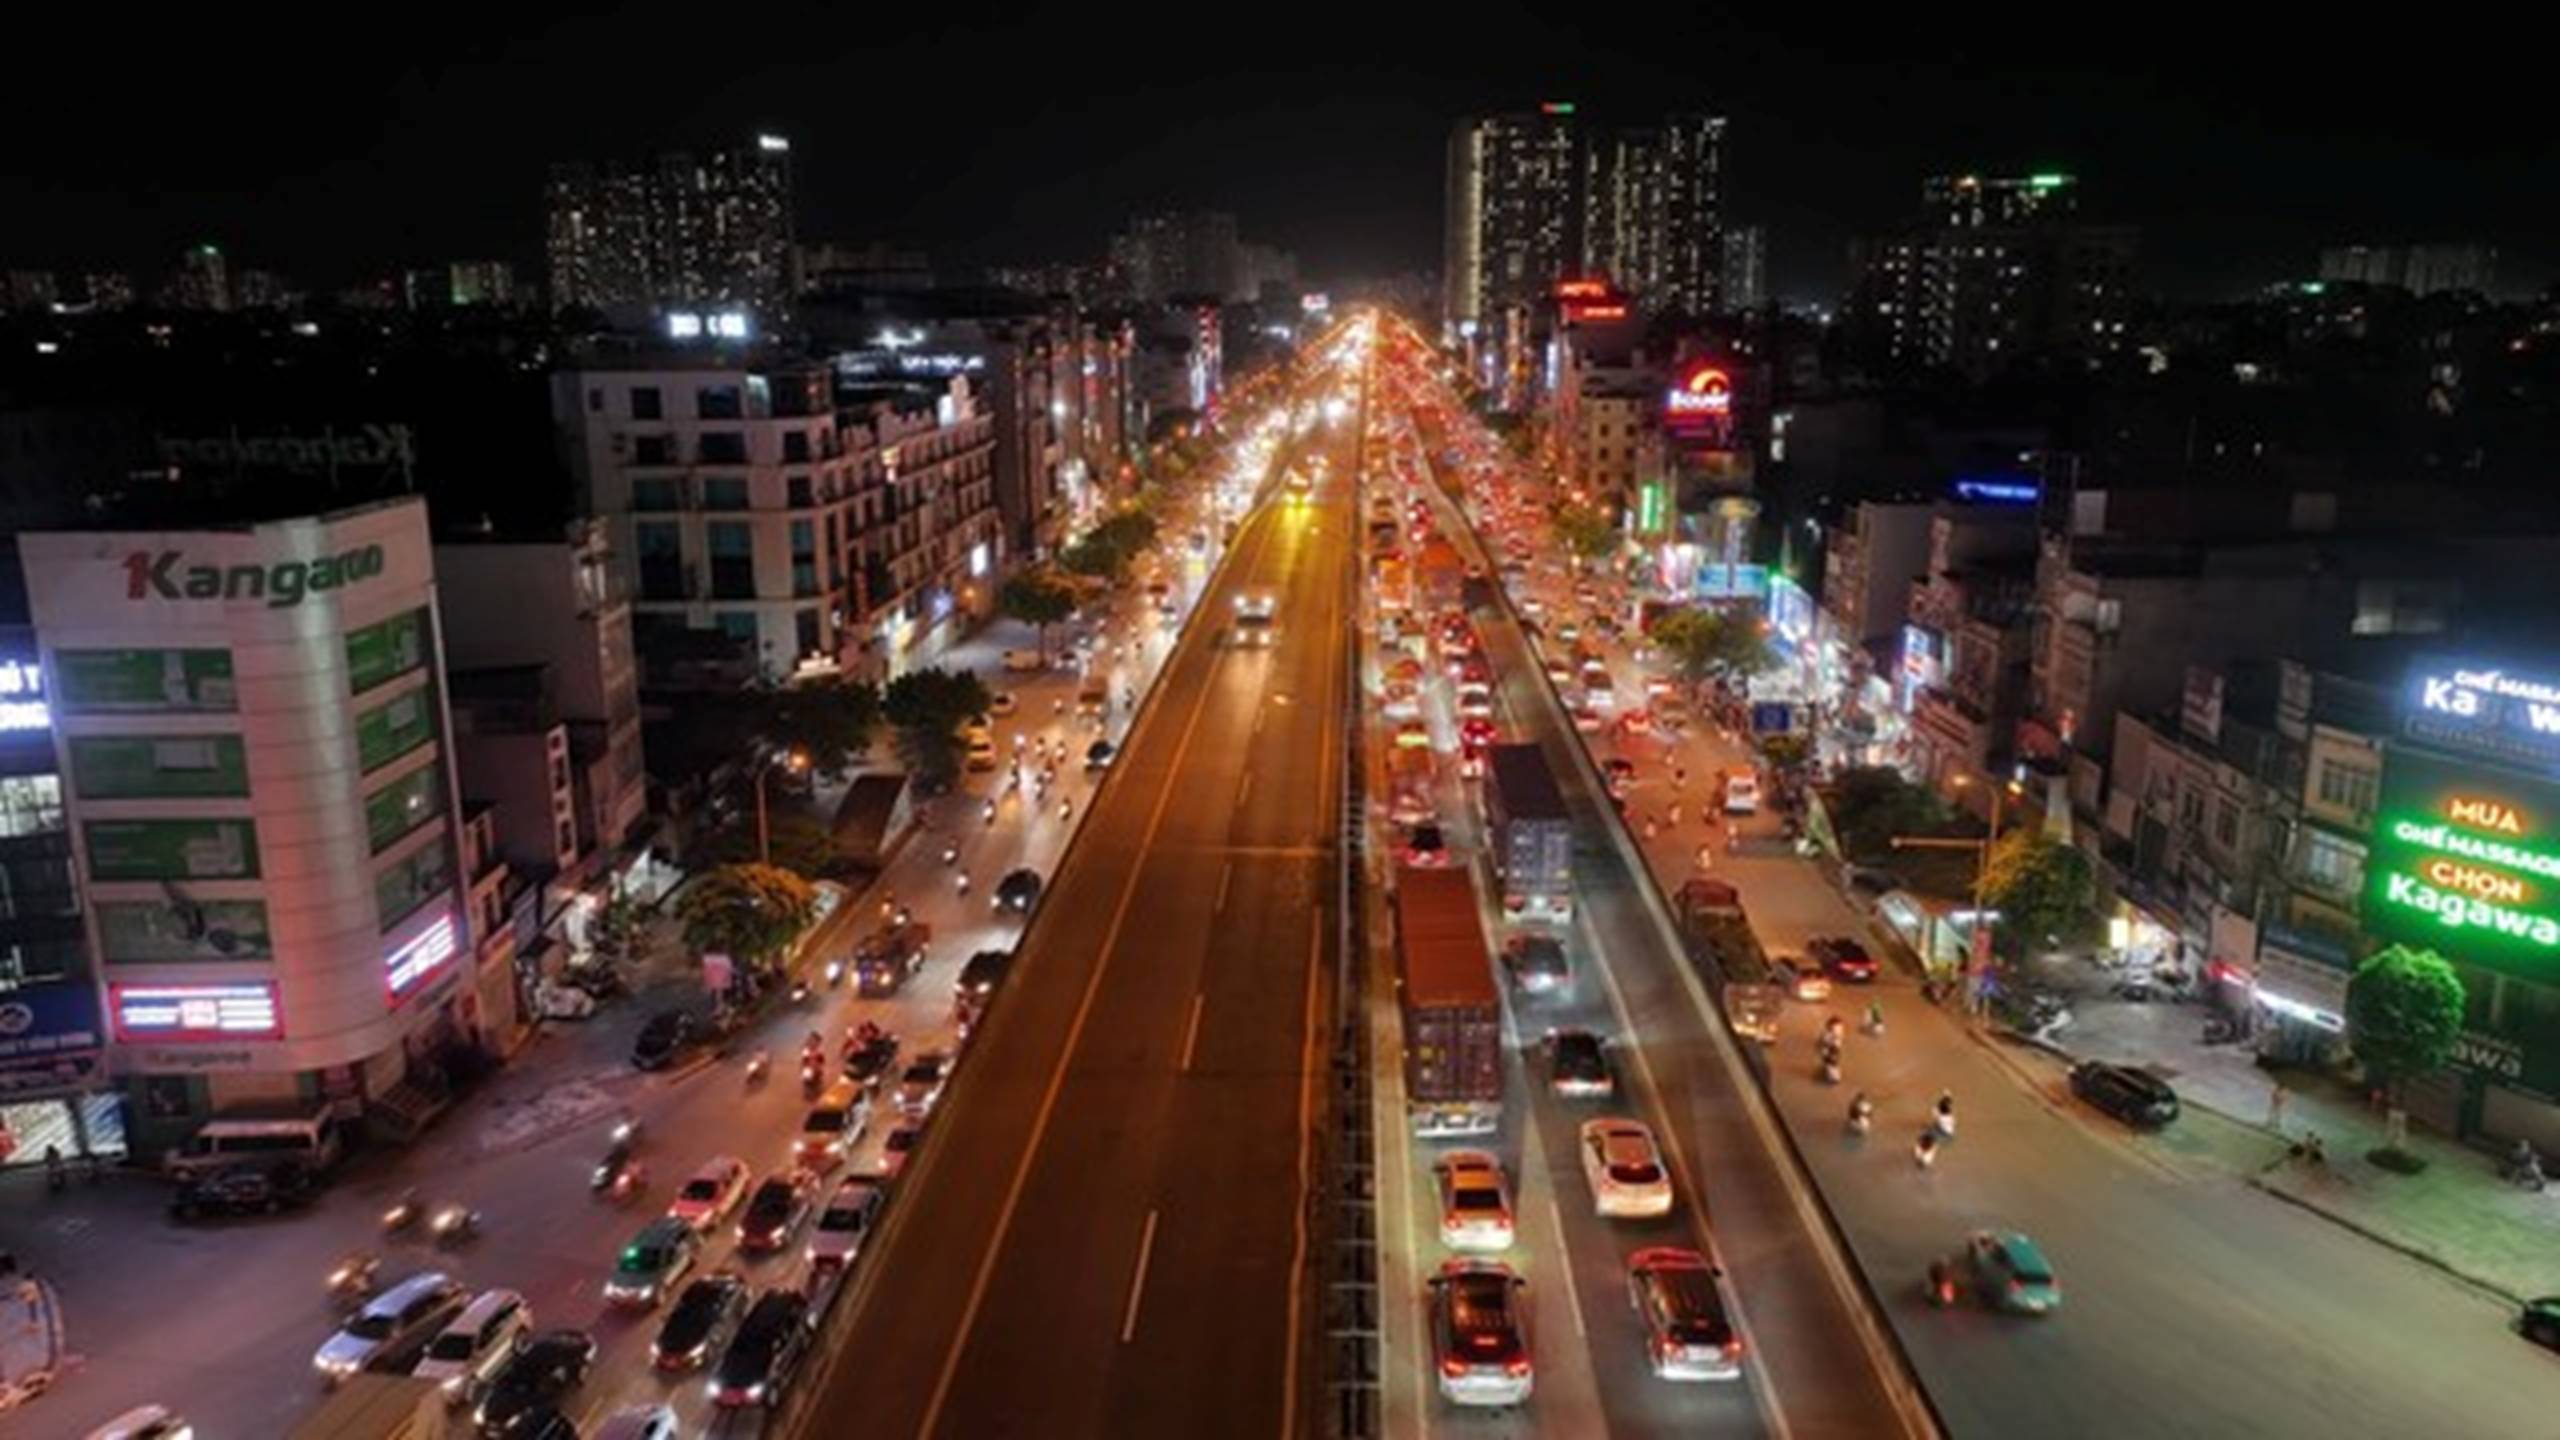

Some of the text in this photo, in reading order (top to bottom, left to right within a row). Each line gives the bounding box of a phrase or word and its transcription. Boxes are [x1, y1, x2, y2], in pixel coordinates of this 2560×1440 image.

[2451, 798, 2520, 833] MUA
[2430, 861, 2521, 902] CHỌN
[2387, 872, 2558, 945] Kagawa
